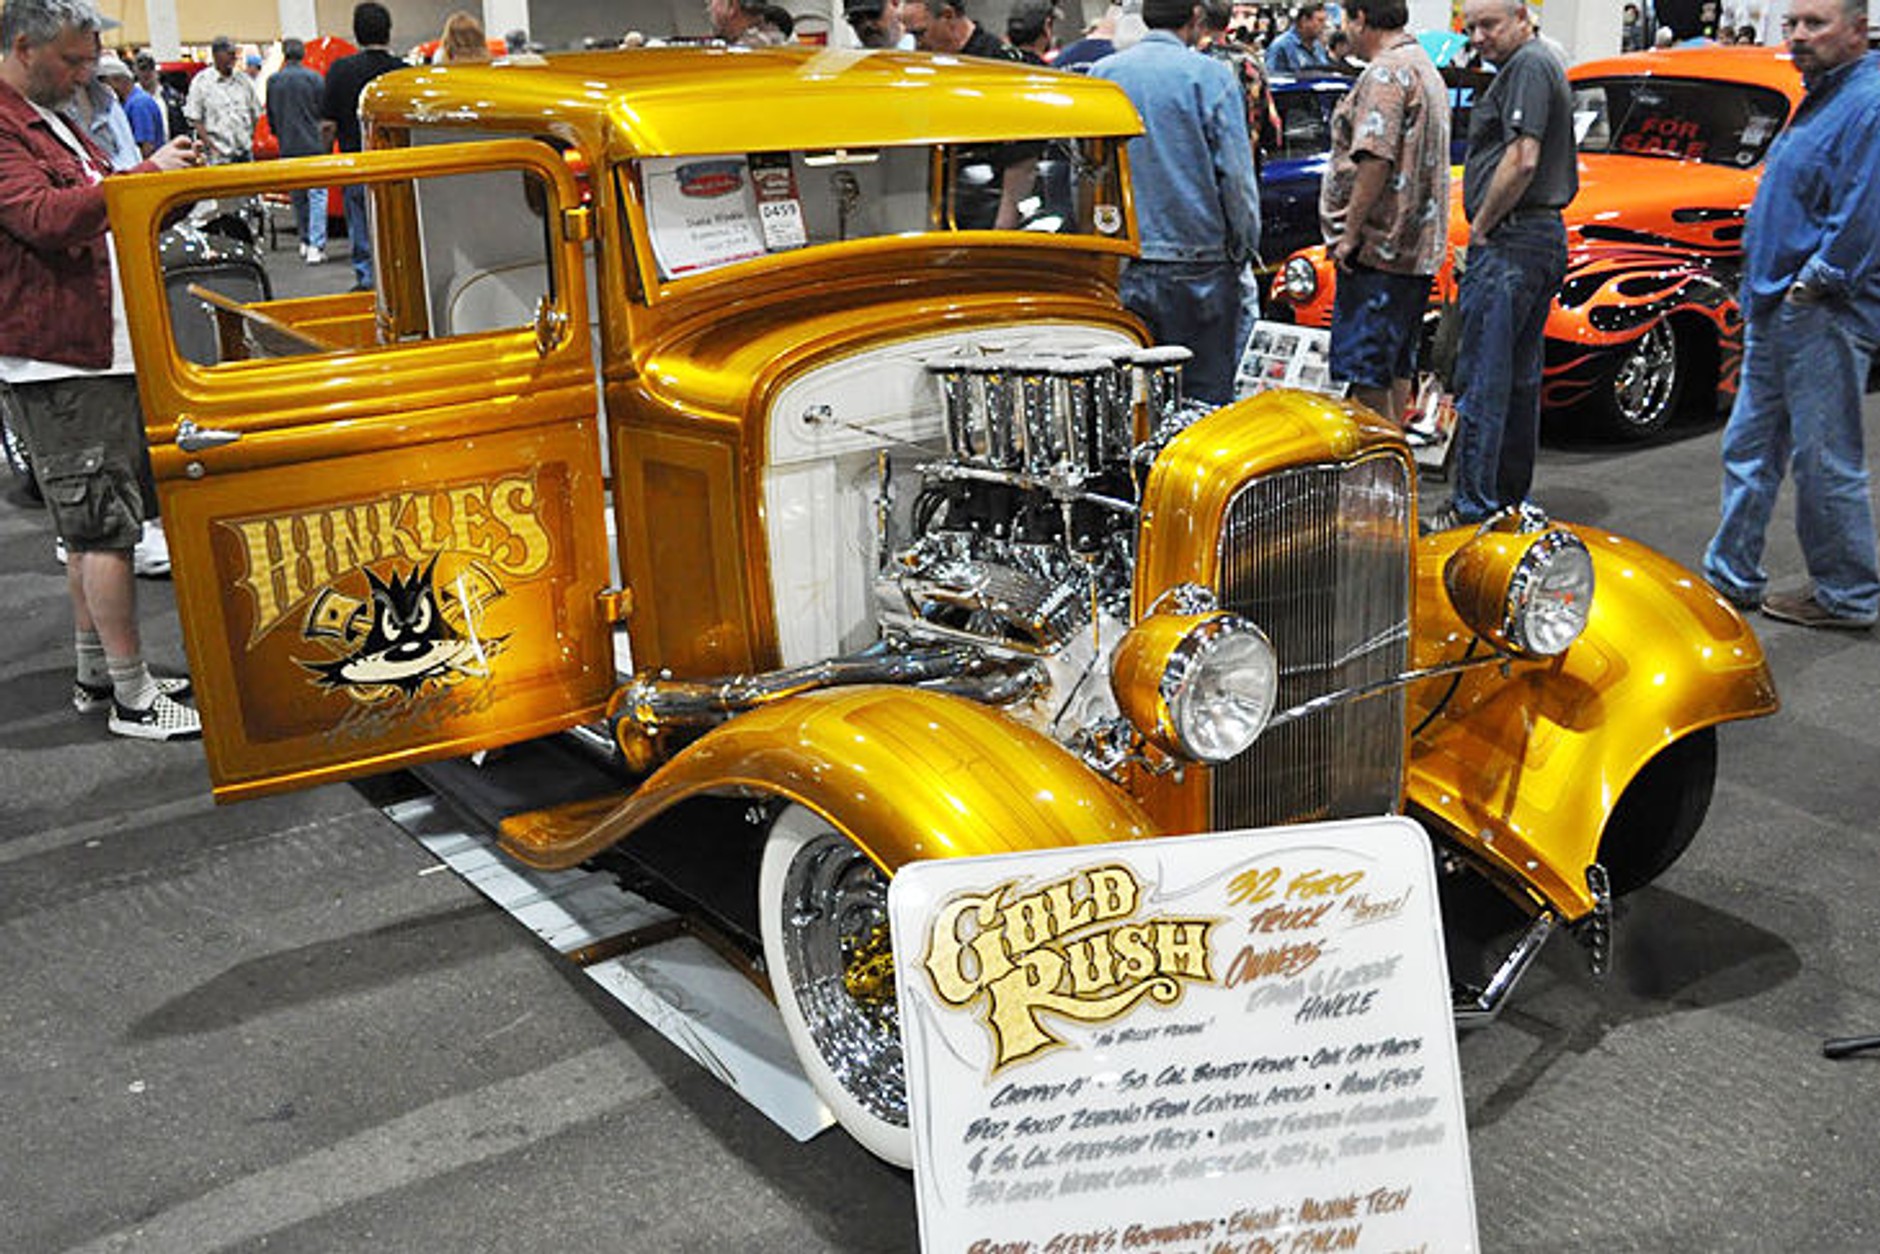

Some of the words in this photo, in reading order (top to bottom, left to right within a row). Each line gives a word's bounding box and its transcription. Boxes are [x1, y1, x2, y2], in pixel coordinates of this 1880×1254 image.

[1641, 116, 1699, 138] FOR
[1621, 133, 1707, 157] SALE
[213, 474, 552, 650] HINKLES
[1227, 866, 1282, 907] 32
[1284, 868, 1365, 900] FORD
[923, 862, 1140, 1005] GOLD
[1249, 900, 1334, 934] TRUCK
[987, 916, 1220, 1079] RUSH
[1294, 988, 1379, 1025] HINKLE
[990, 1083, 1066, 1110] CHOPPED
[1364, 1184, 1412, 1216] TECH
